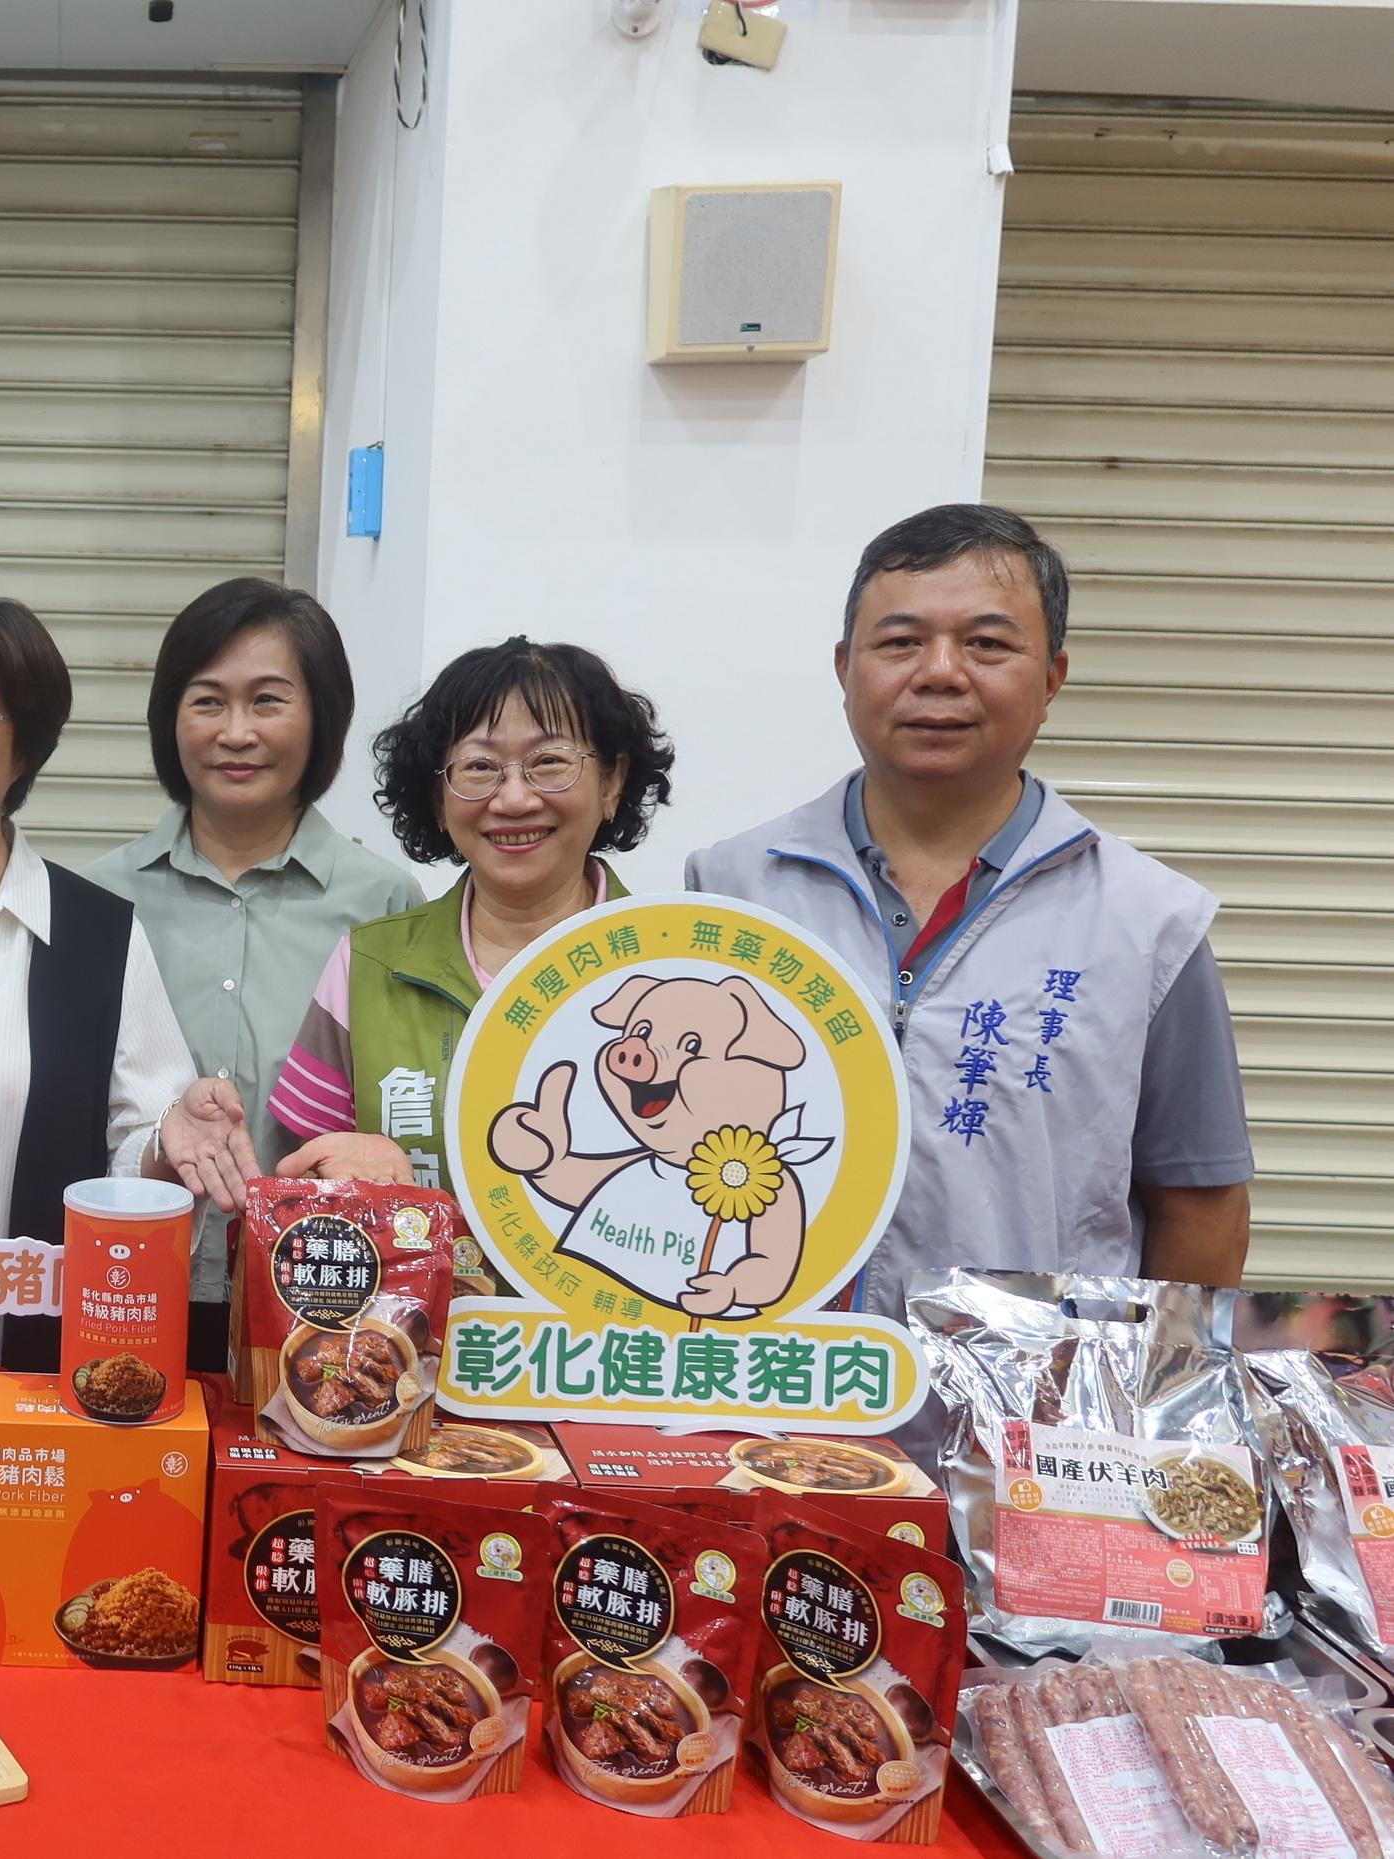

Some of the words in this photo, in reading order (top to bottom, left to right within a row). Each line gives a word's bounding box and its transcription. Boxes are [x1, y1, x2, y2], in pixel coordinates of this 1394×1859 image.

[1023, 968, 1081, 1093] 理事長
[306, 1238, 357, 1263] 藥膳
[487, 1184, 583, 1297] 彰化縣政府
[593, 1288, 644, 1321] 輔導
[589, 1207, 656, 1257] Health
[662, 1229, 696, 1266] Pig
[293, 1263, 370, 1289] 軟豚排
[81, 1287, 158, 1305] 彰化縣肉品市場
[81, 1300, 158, 1322] 特級豬肉鬆
[80, 1318, 103, 1332] Fried
[105, 1322, 129, 1334] Pork
[131, 1323, 158, 1334] Fiber
[455, 1323, 890, 1409] 彰化健康豬肉
[1035, 1453, 1169, 1490] 國產伏羊肉
[29, 1490, 66, 1503] Fiber
[378, 1556, 434, 1585] 藥膳
[593, 1559, 649, 1595] 藥膳
[366, 1580, 450, 1616] 軟豚排
[576, 1584, 663, 1627] 軟豚排
[800, 1572, 855, 1614] 藥膳
[784, 1595, 869, 1648] 軟豚排
